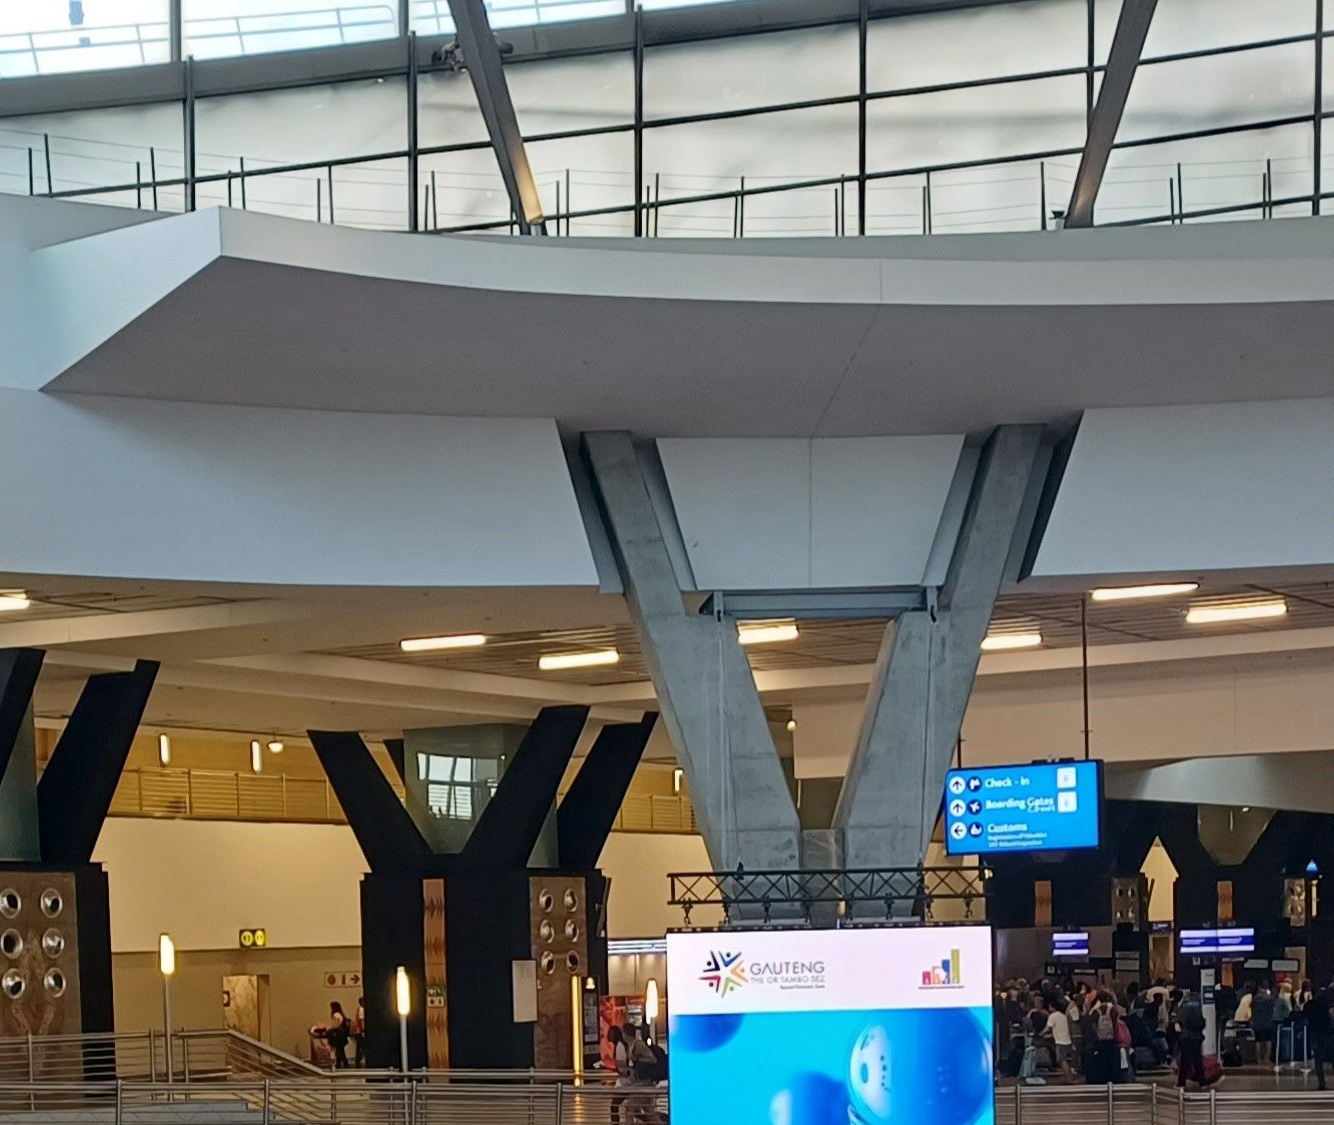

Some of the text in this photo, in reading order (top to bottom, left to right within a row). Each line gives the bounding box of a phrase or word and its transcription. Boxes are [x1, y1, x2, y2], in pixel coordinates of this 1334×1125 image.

[986, 798, 1026, 810] Boarding
[987, 823, 1027, 833] Customs
[750, 961, 825, 975] GAUTENG
